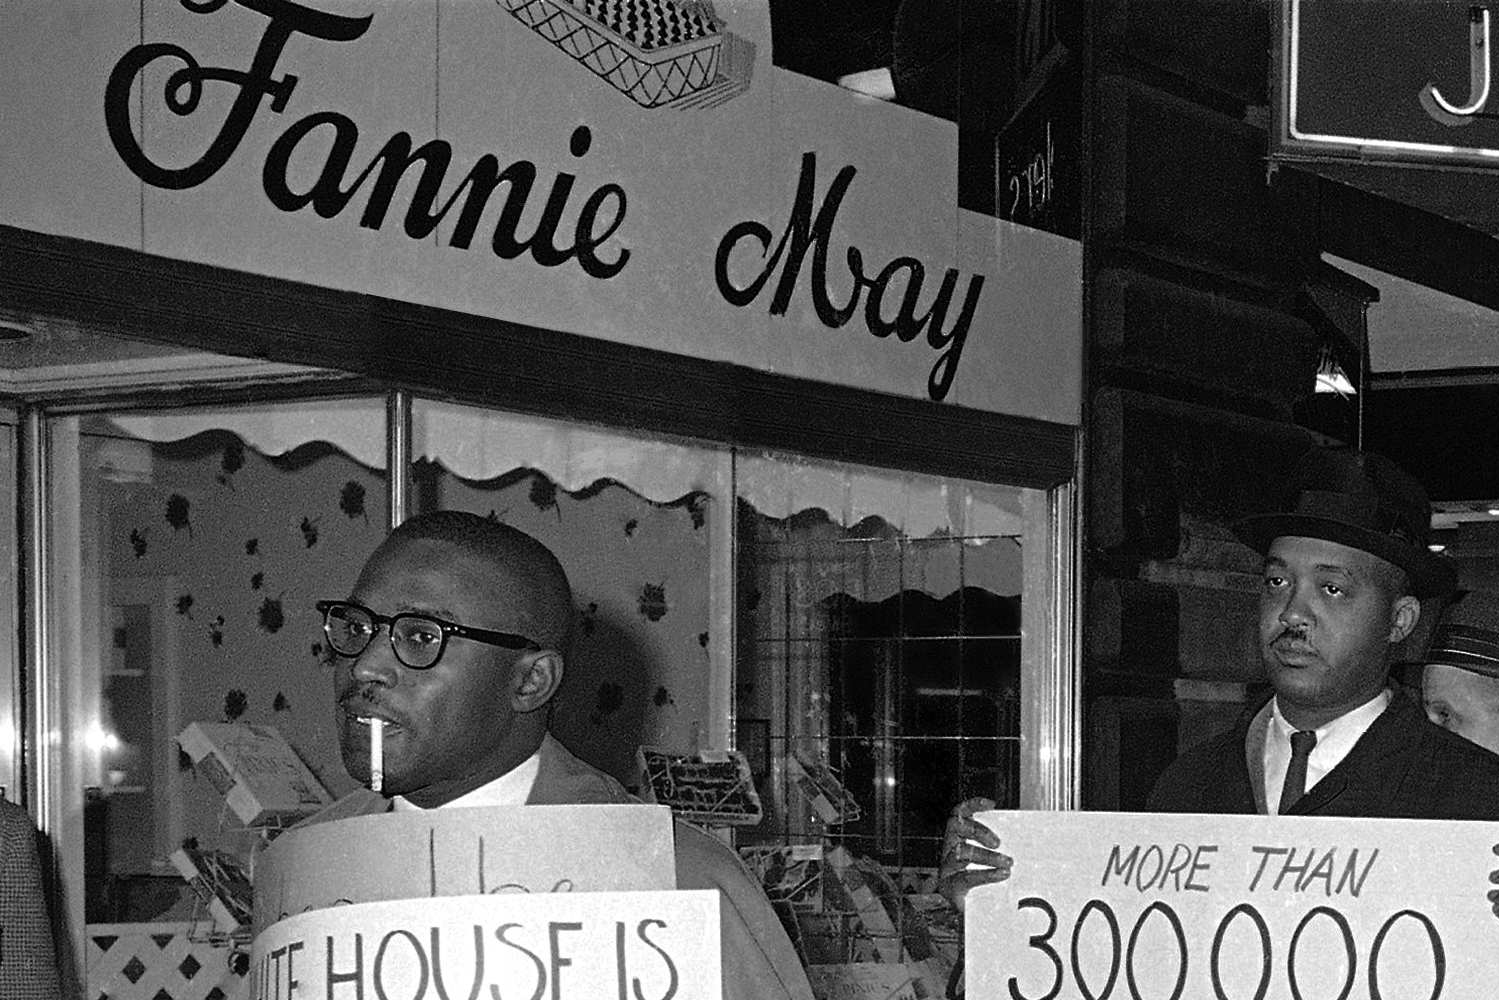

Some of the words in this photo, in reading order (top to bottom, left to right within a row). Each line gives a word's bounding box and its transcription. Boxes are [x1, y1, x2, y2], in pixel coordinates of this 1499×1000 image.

[104, 0, 631, 279] Fannie
[714, 150, 985, 400] May
[1101, 844, 1219, 893] MORE
[1247, 844, 1380, 898] THAN
